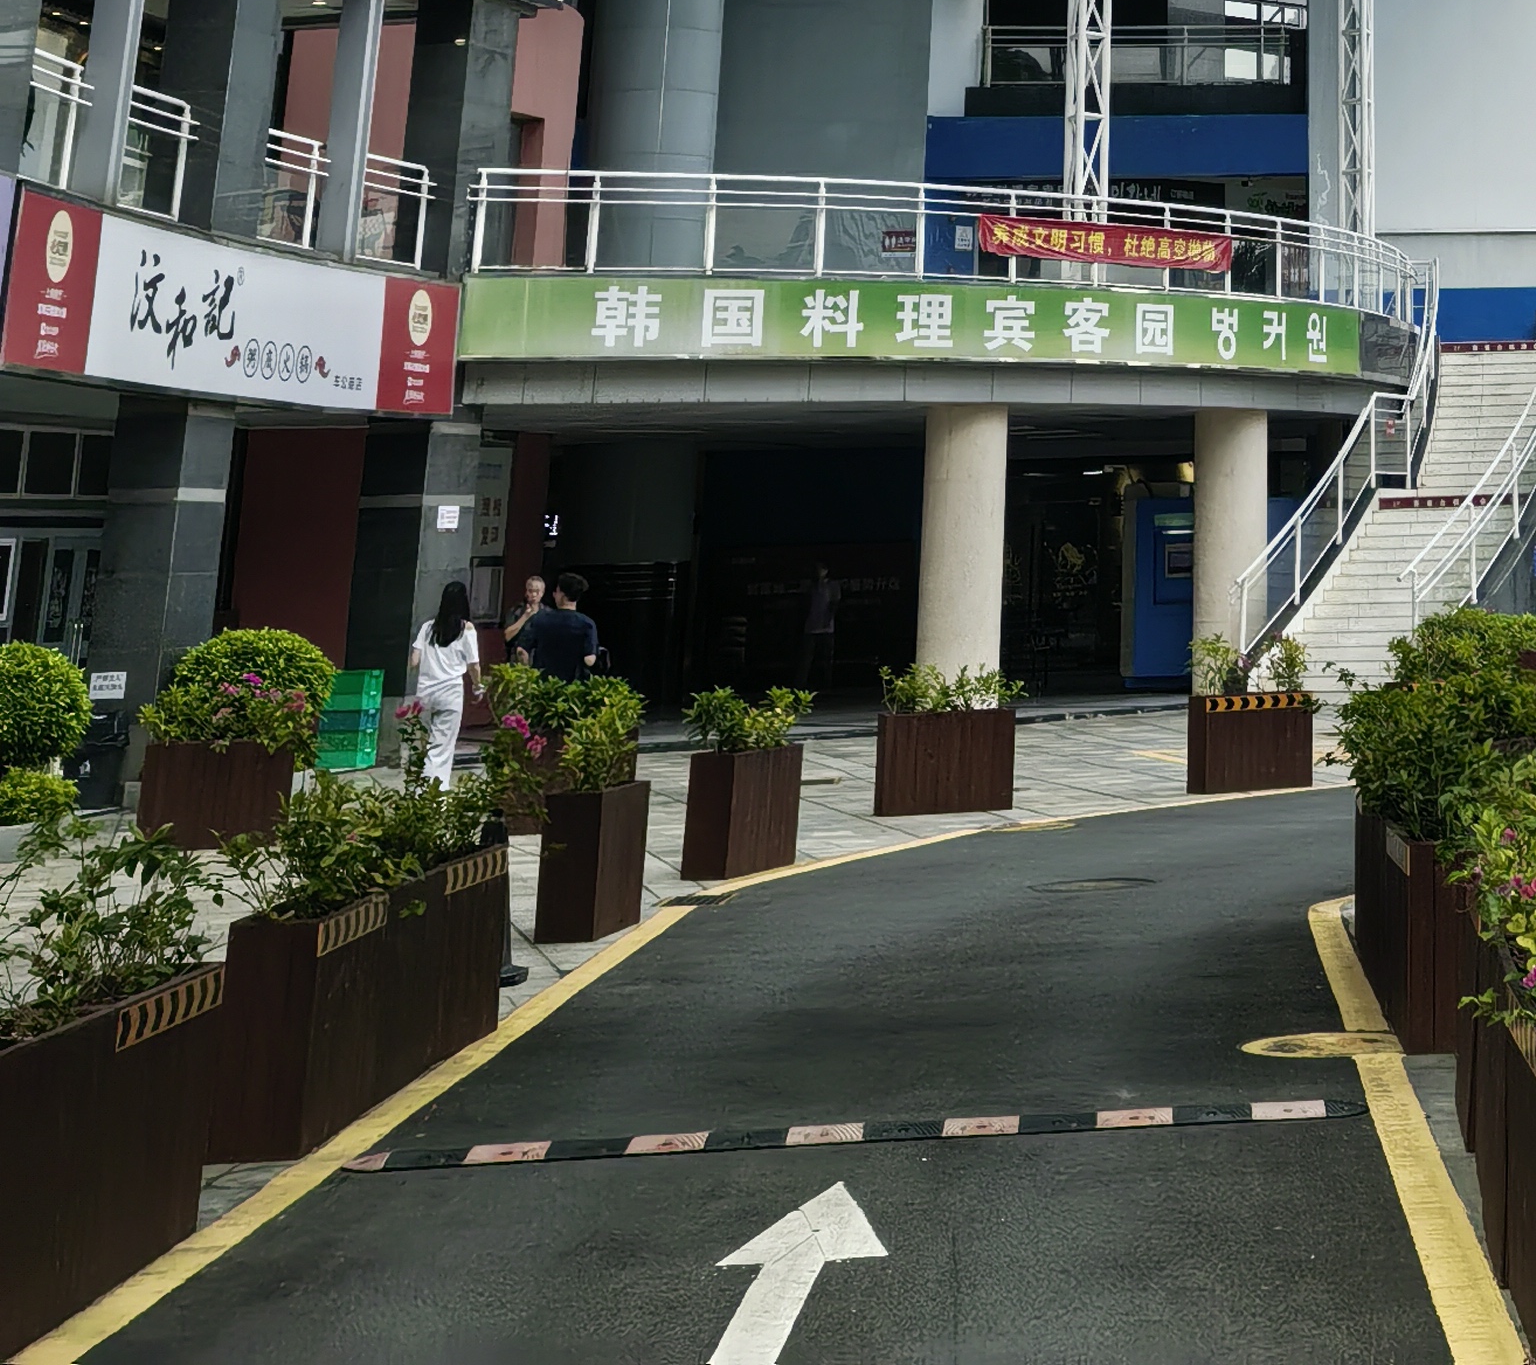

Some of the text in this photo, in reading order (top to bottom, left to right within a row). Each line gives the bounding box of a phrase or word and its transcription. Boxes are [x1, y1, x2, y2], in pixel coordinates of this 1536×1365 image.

[591, 285, 1327, 363] 韩国料理宾客园 벙커원
